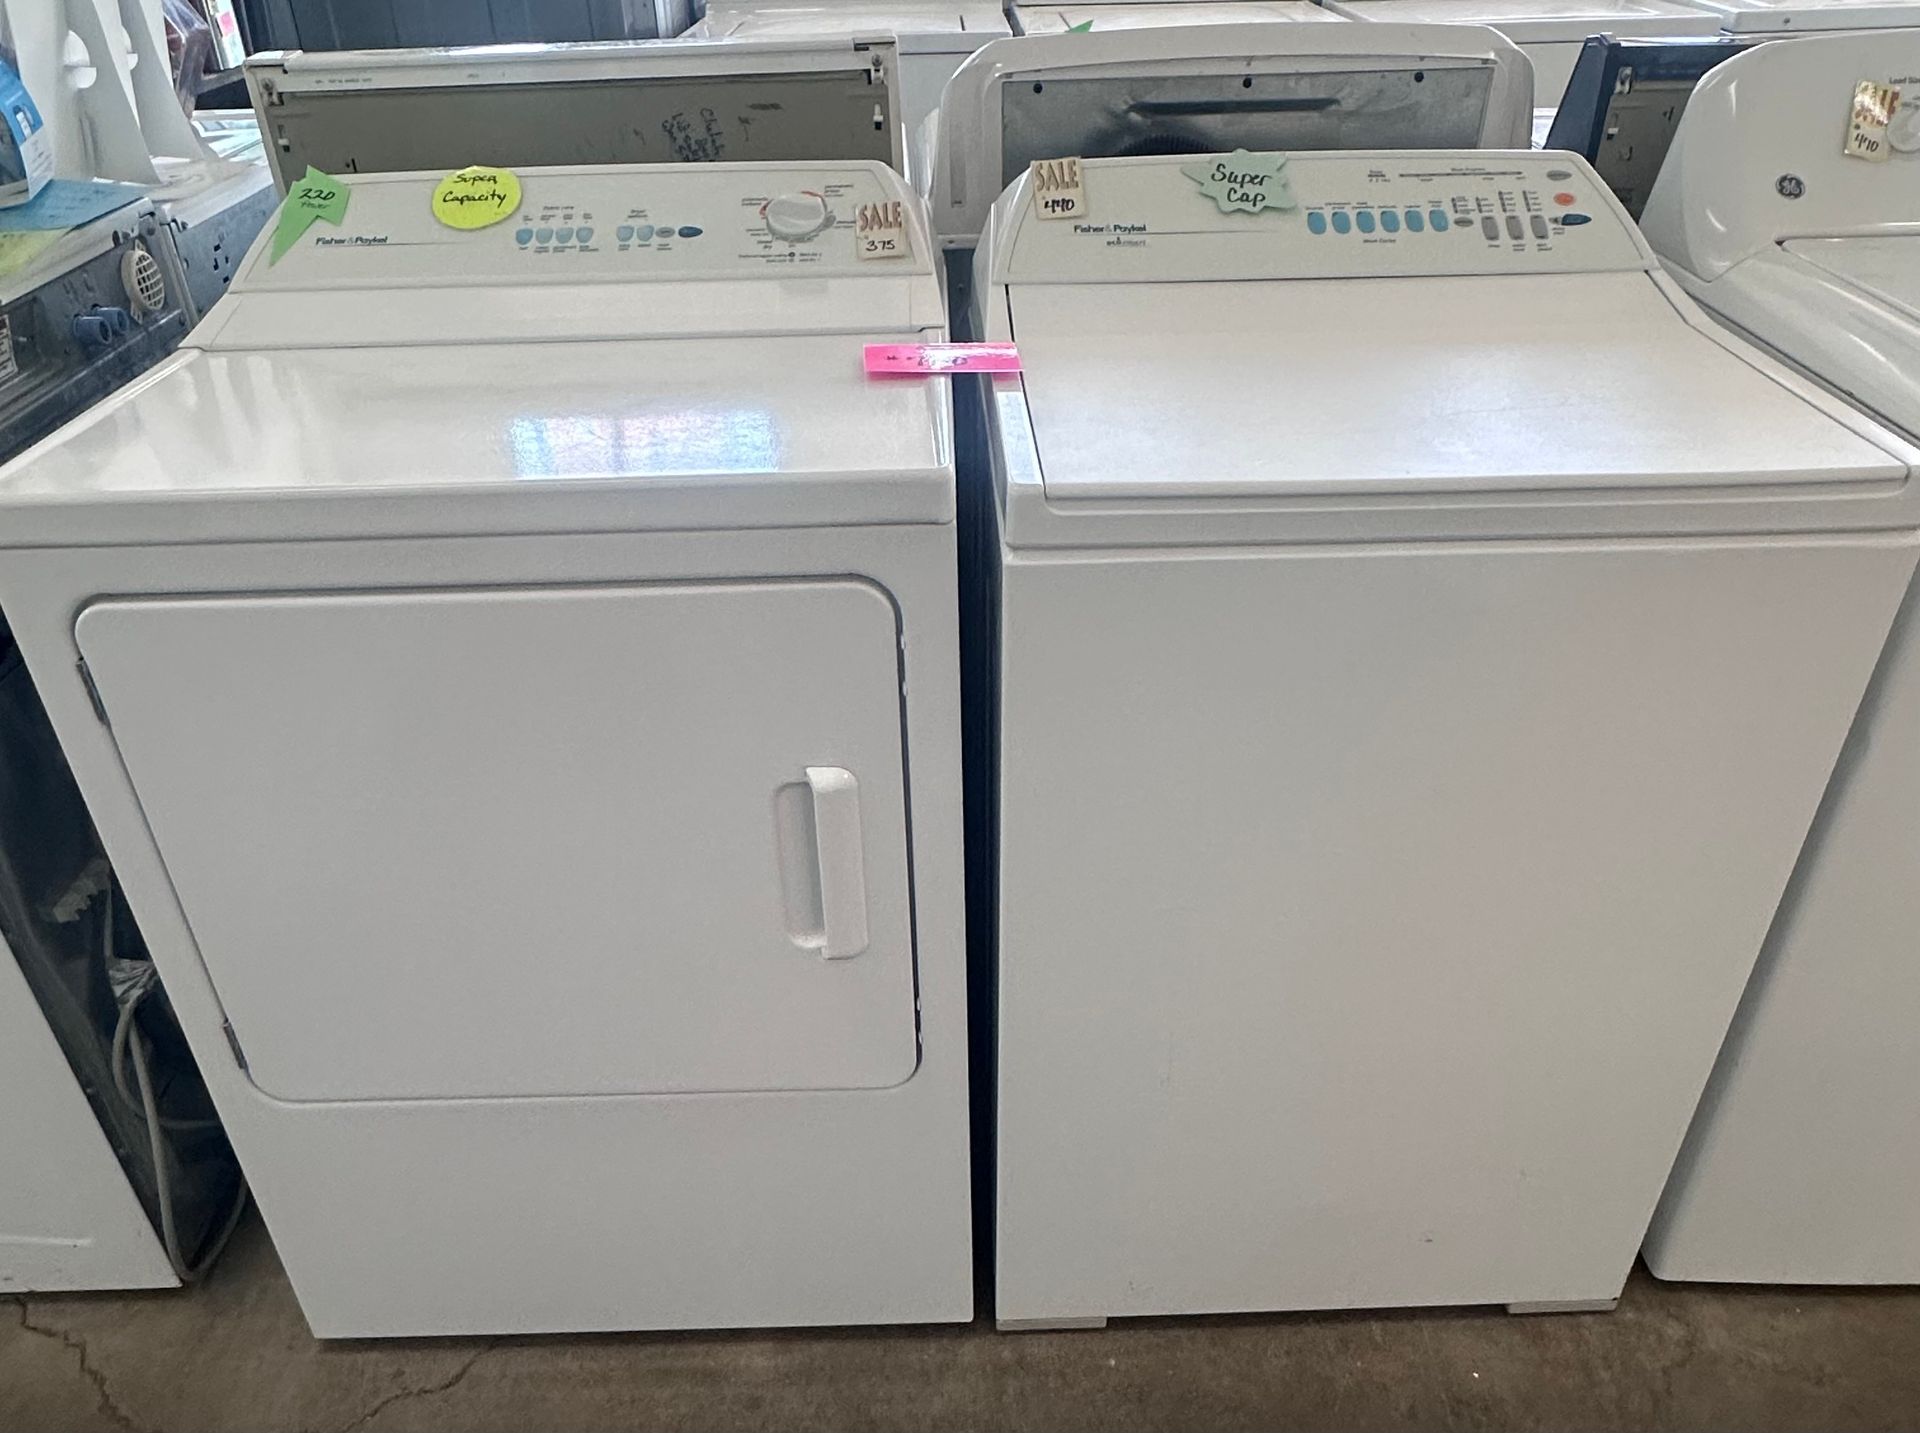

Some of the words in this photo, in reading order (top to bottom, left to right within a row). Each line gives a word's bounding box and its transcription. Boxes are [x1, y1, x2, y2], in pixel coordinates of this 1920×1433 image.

[1035, 159, 1079, 192] SALE
[1211, 163, 1273, 189] Super
[298, 188, 335, 201] 220
[442, 189, 507, 208] Capacity
[1227, 187, 1266, 208] Cap
[859, 201, 902, 232] SALE
[866, 240, 895, 252] 375
